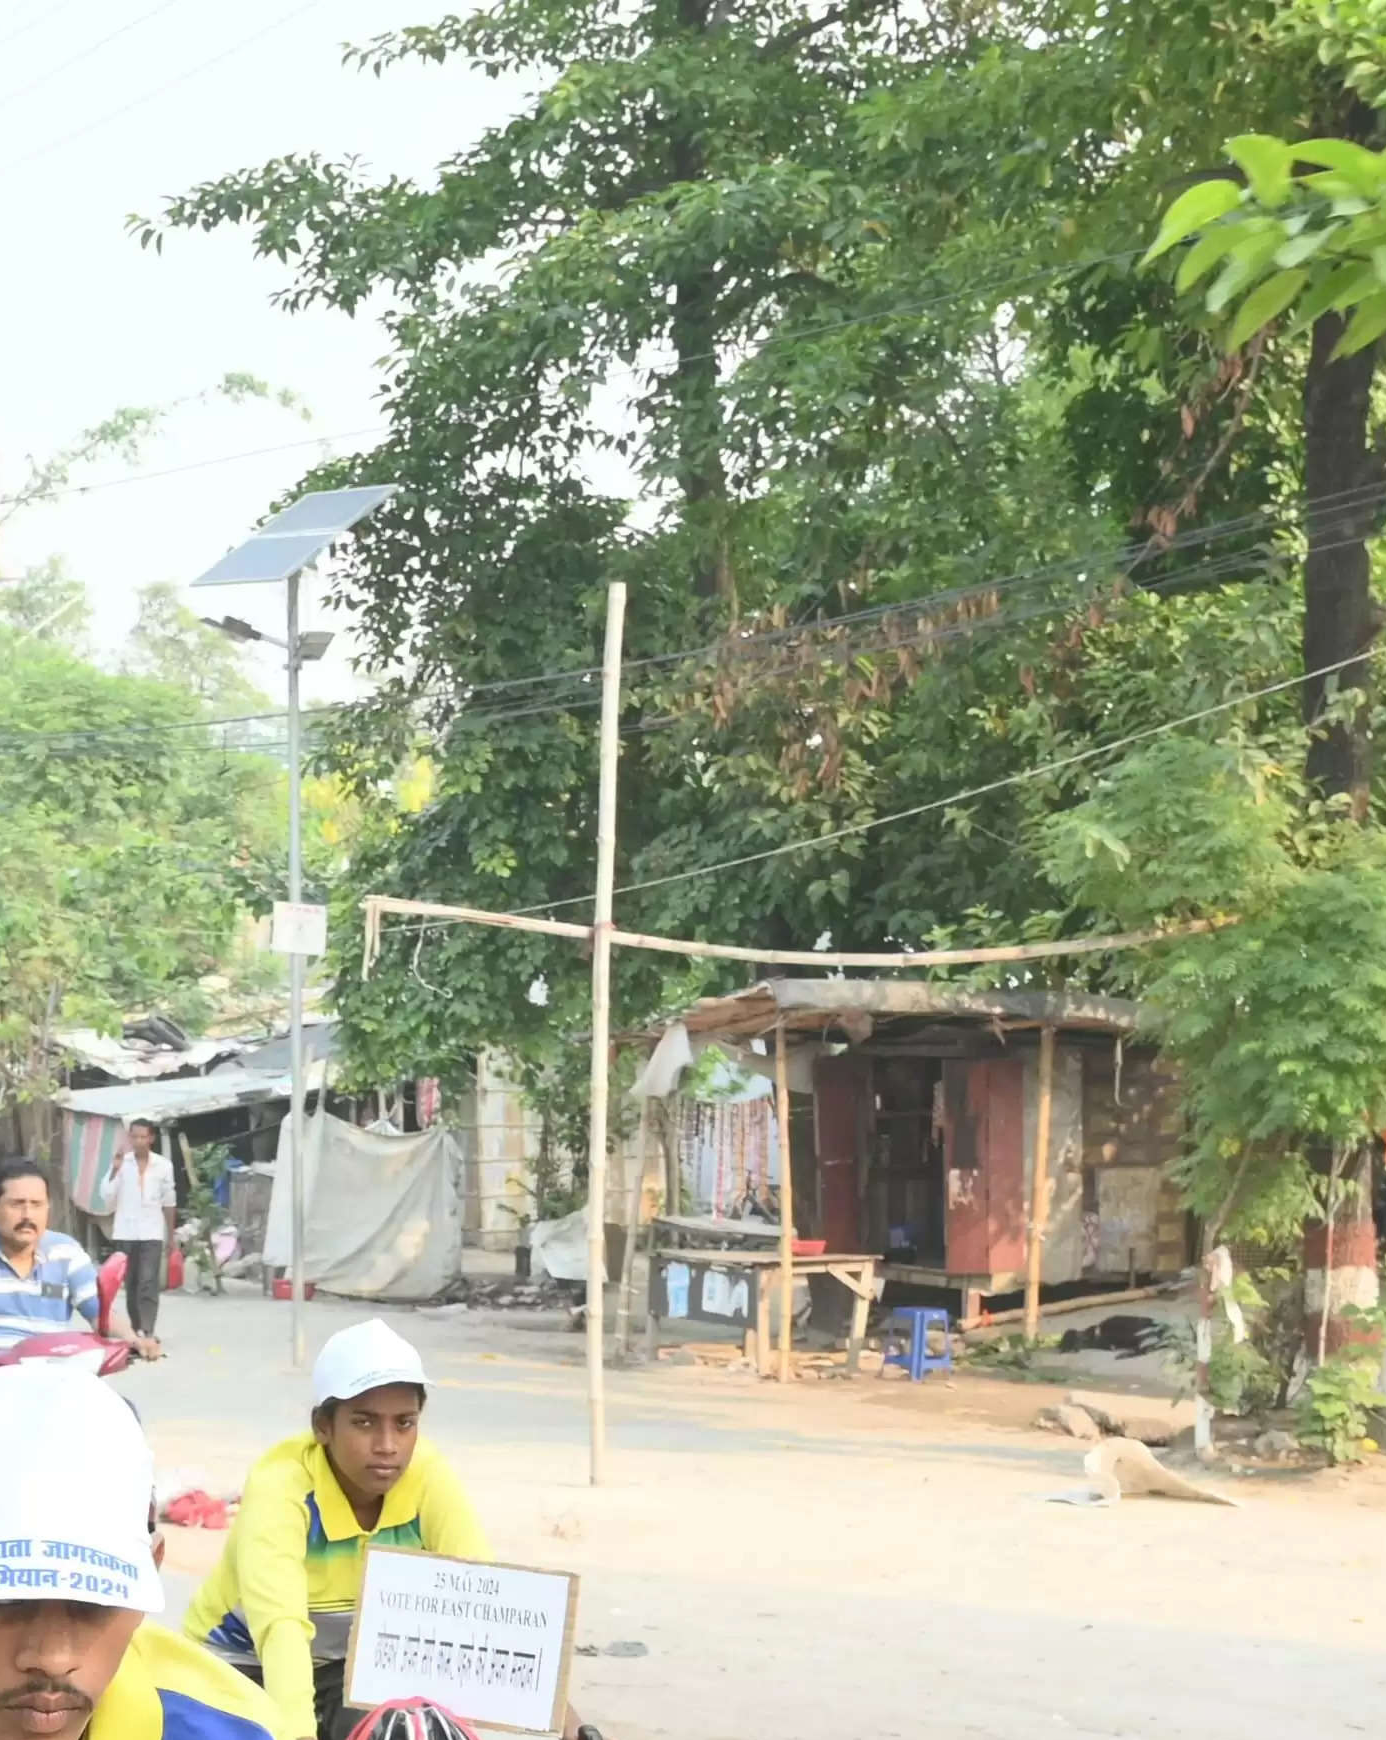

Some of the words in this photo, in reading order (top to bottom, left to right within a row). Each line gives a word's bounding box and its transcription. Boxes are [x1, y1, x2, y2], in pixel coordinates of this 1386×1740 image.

[477, 1577, 500, 1597] 2024
[379, 1589, 413, 1610] VOTE
[414, 1596, 439, 1614] FOR
[441, 1600, 472, 1618] EAST
[473, 1602, 548, 1628] CHAMPARAN
